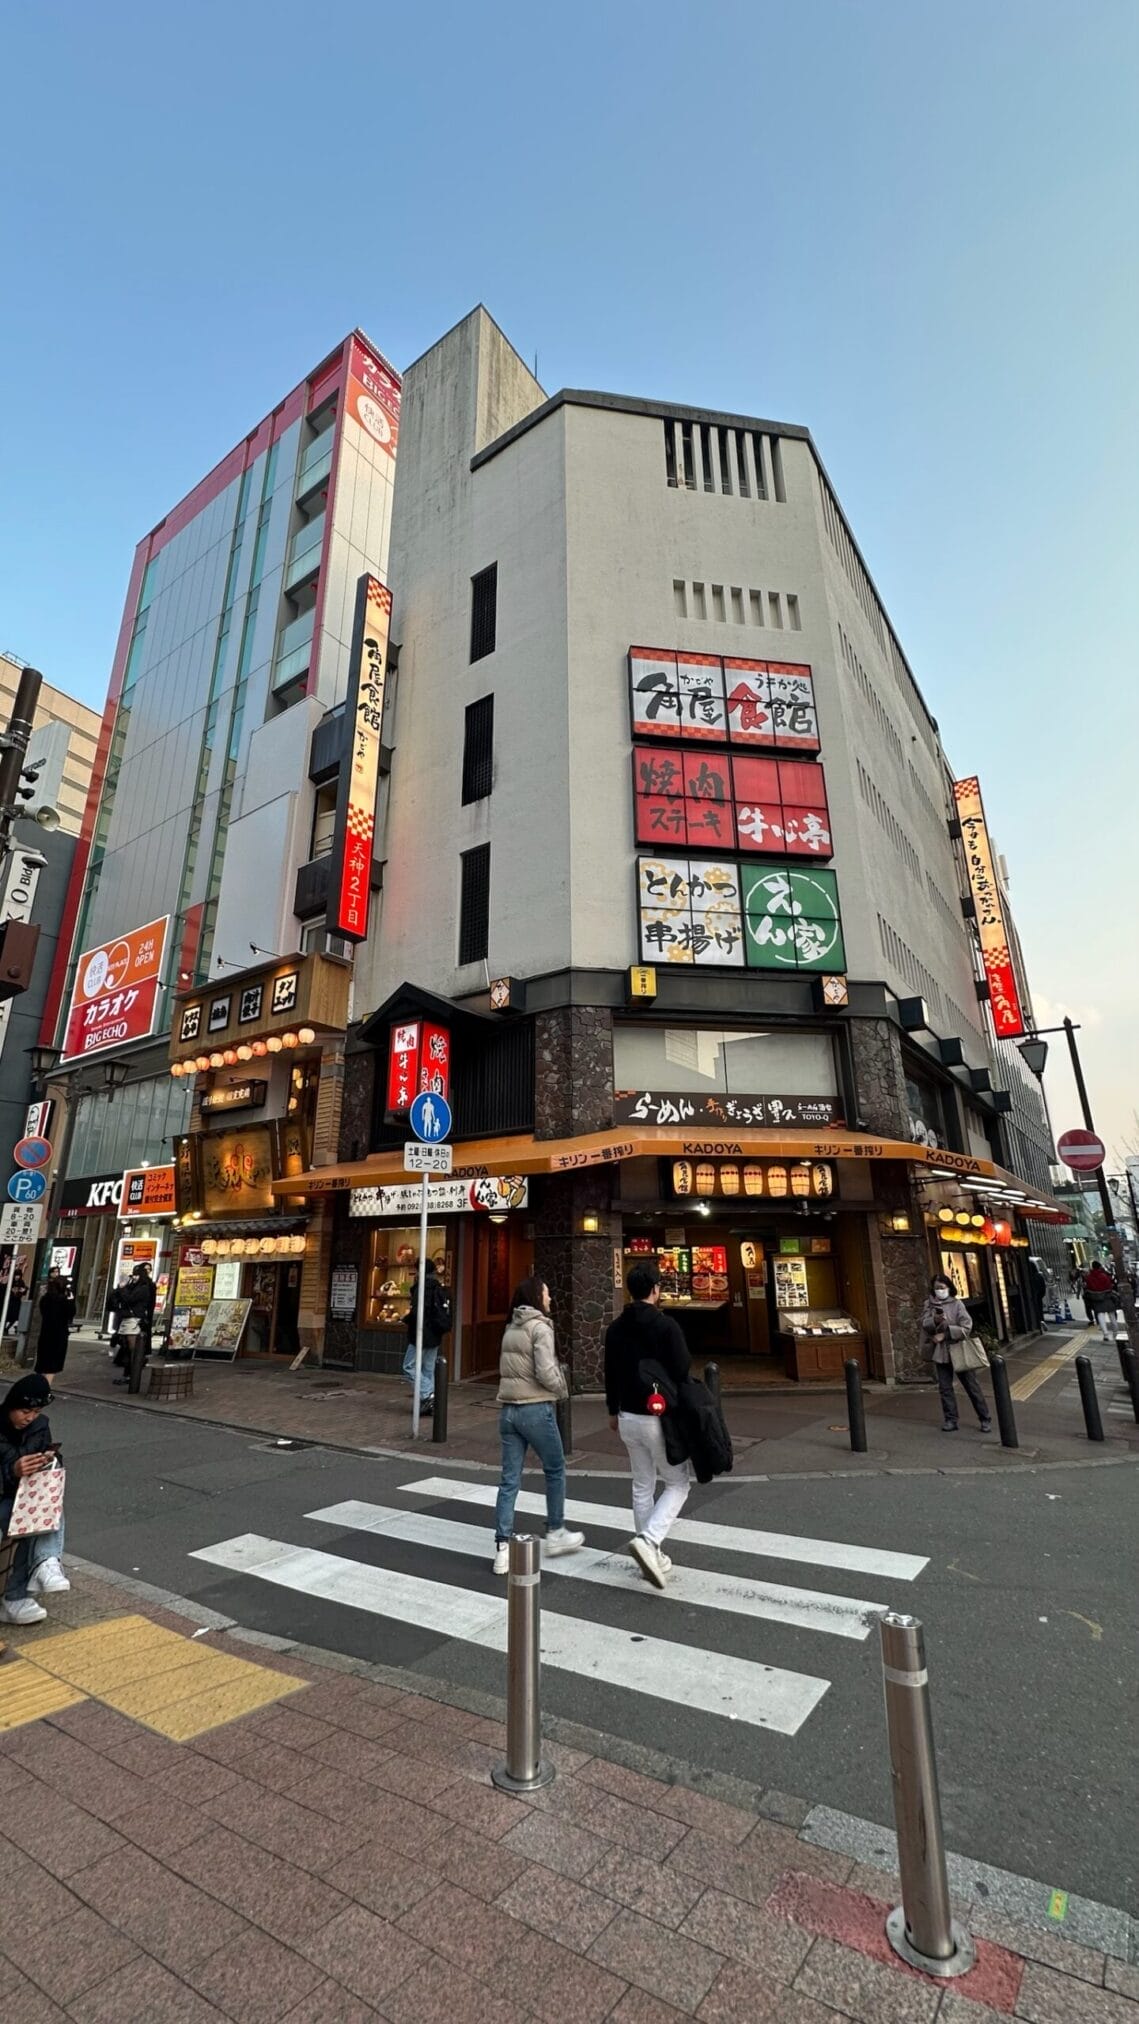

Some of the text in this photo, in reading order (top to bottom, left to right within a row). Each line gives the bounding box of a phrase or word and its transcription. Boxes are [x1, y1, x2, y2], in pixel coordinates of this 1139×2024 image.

[640, 757, 726, 808] 焼肉
[650, 808, 722, 838] ステーキ
[348, 842, 365, 926] 天神2丁目
[645, 870, 738, 899] とんかつ
[645, 920, 743, 955] 串揚げ
[134, 950, 155, 968] OPEN
[84, 989, 140, 1026] カラオケ
[85, 1031, 102, 1050] BIG
[102, 1021, 128, 1039] ECHO
[801, 1113, 829, 1122] TOYO-Q
[682, 1143, 743, 1154] KADOYA
[925, 1151, 981, 1172] KADOYA
[15, 1178, 32, 1199] P
[86, 1180, 123, 1208] KFC
[456, 1198, 468, 1209] 3F
